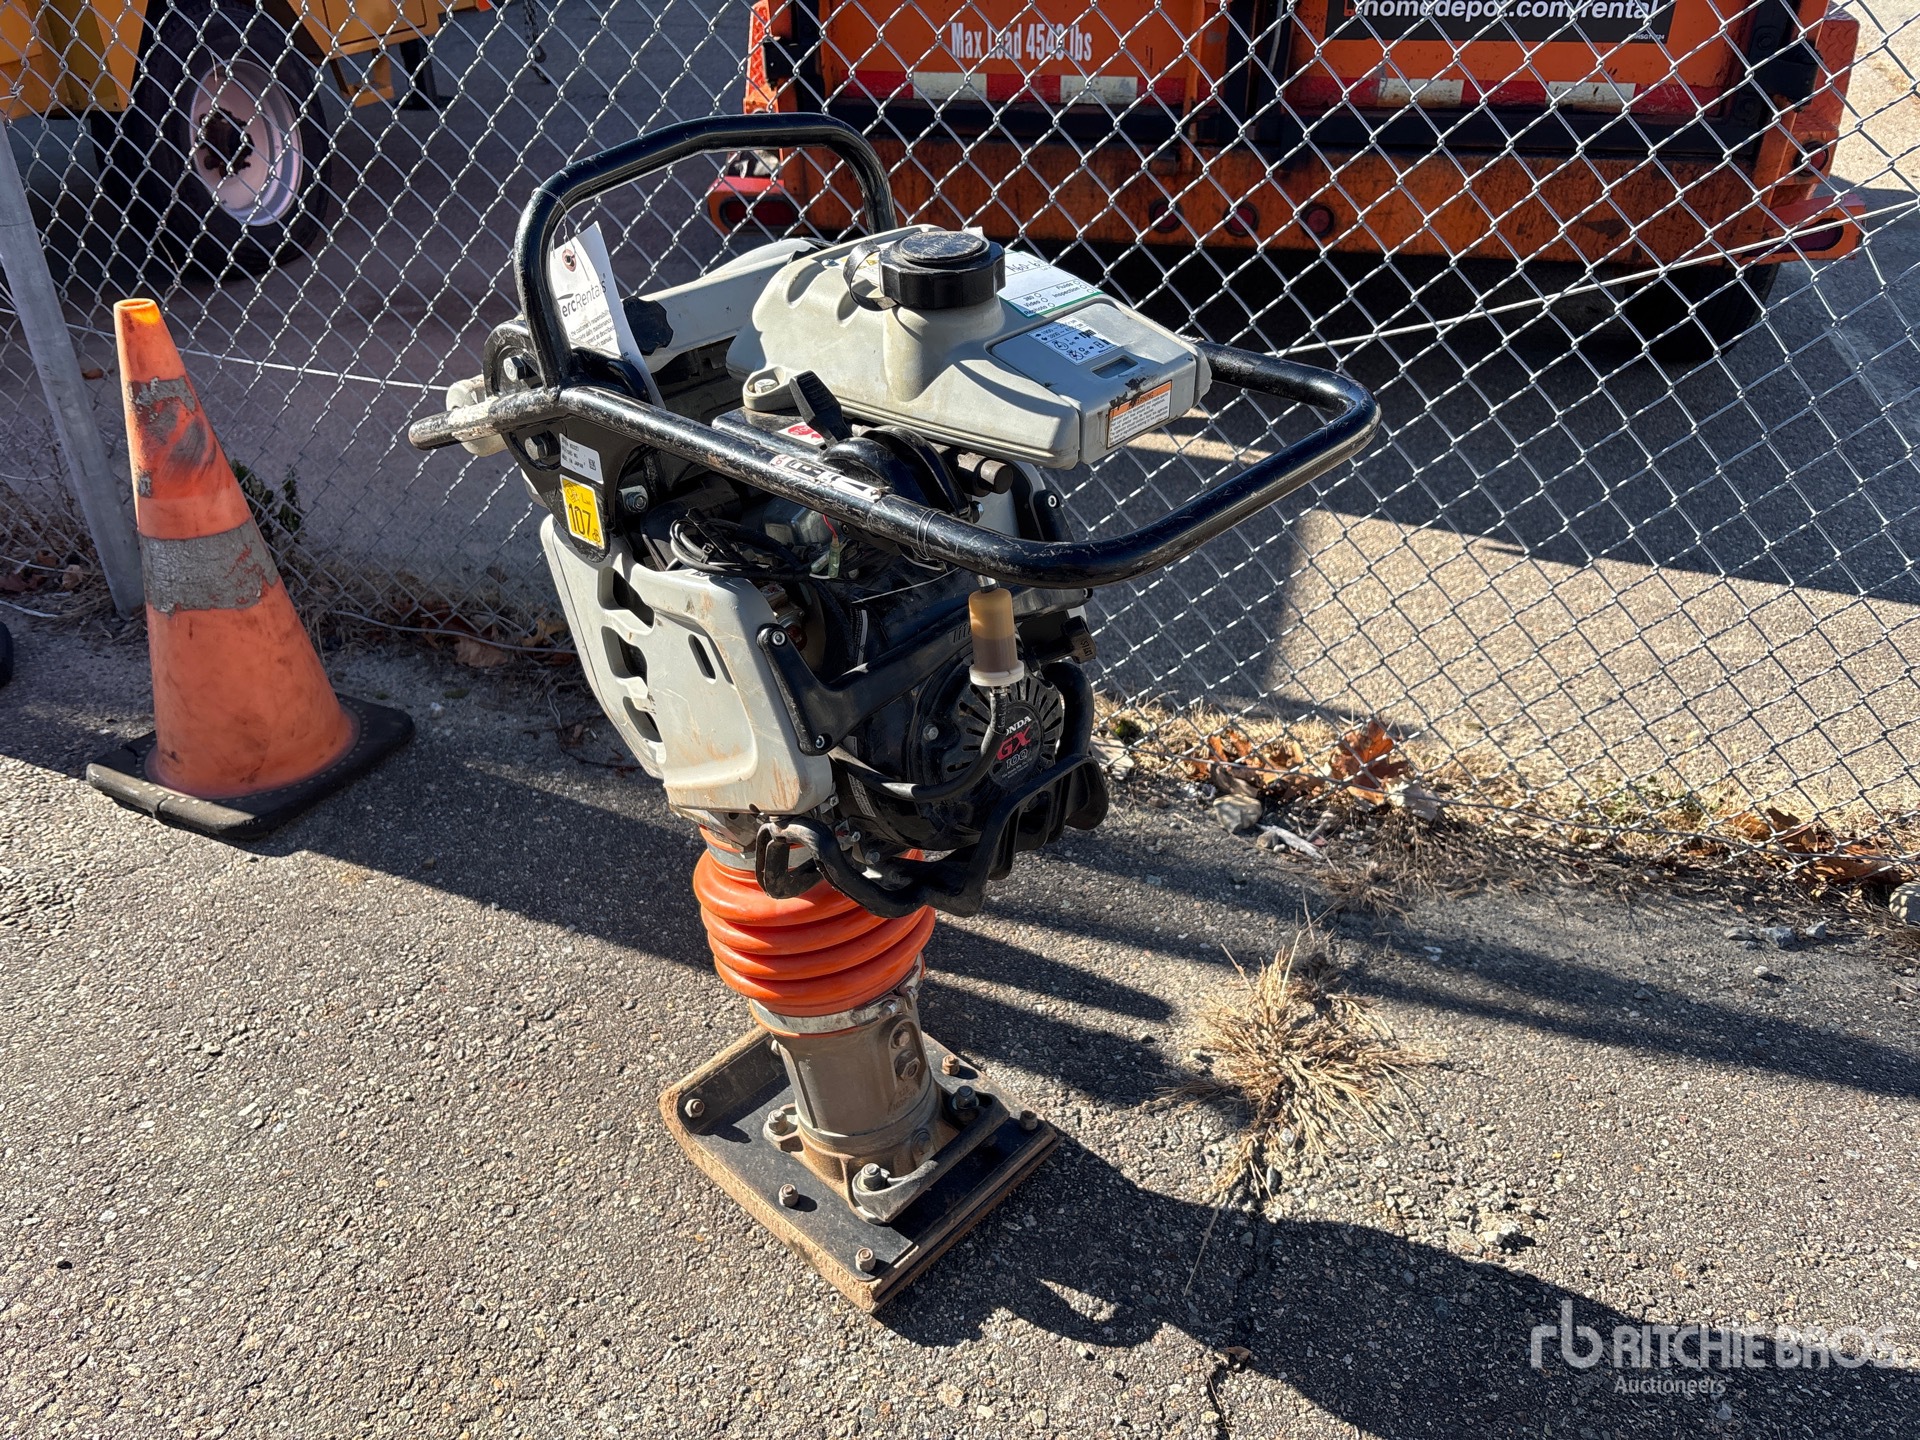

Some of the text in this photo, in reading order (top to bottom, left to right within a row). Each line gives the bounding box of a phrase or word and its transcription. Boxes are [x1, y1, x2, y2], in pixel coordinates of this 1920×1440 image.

[951, 23, 982, 58] Max
[1070, 24, 1092, 61] lbs
[561, 281, 607, 318] ercRentals
[569, 503, 592, 537] 107
[997, 724, 1032, 760] GX
[1006, 748, 1028, 769] 100
